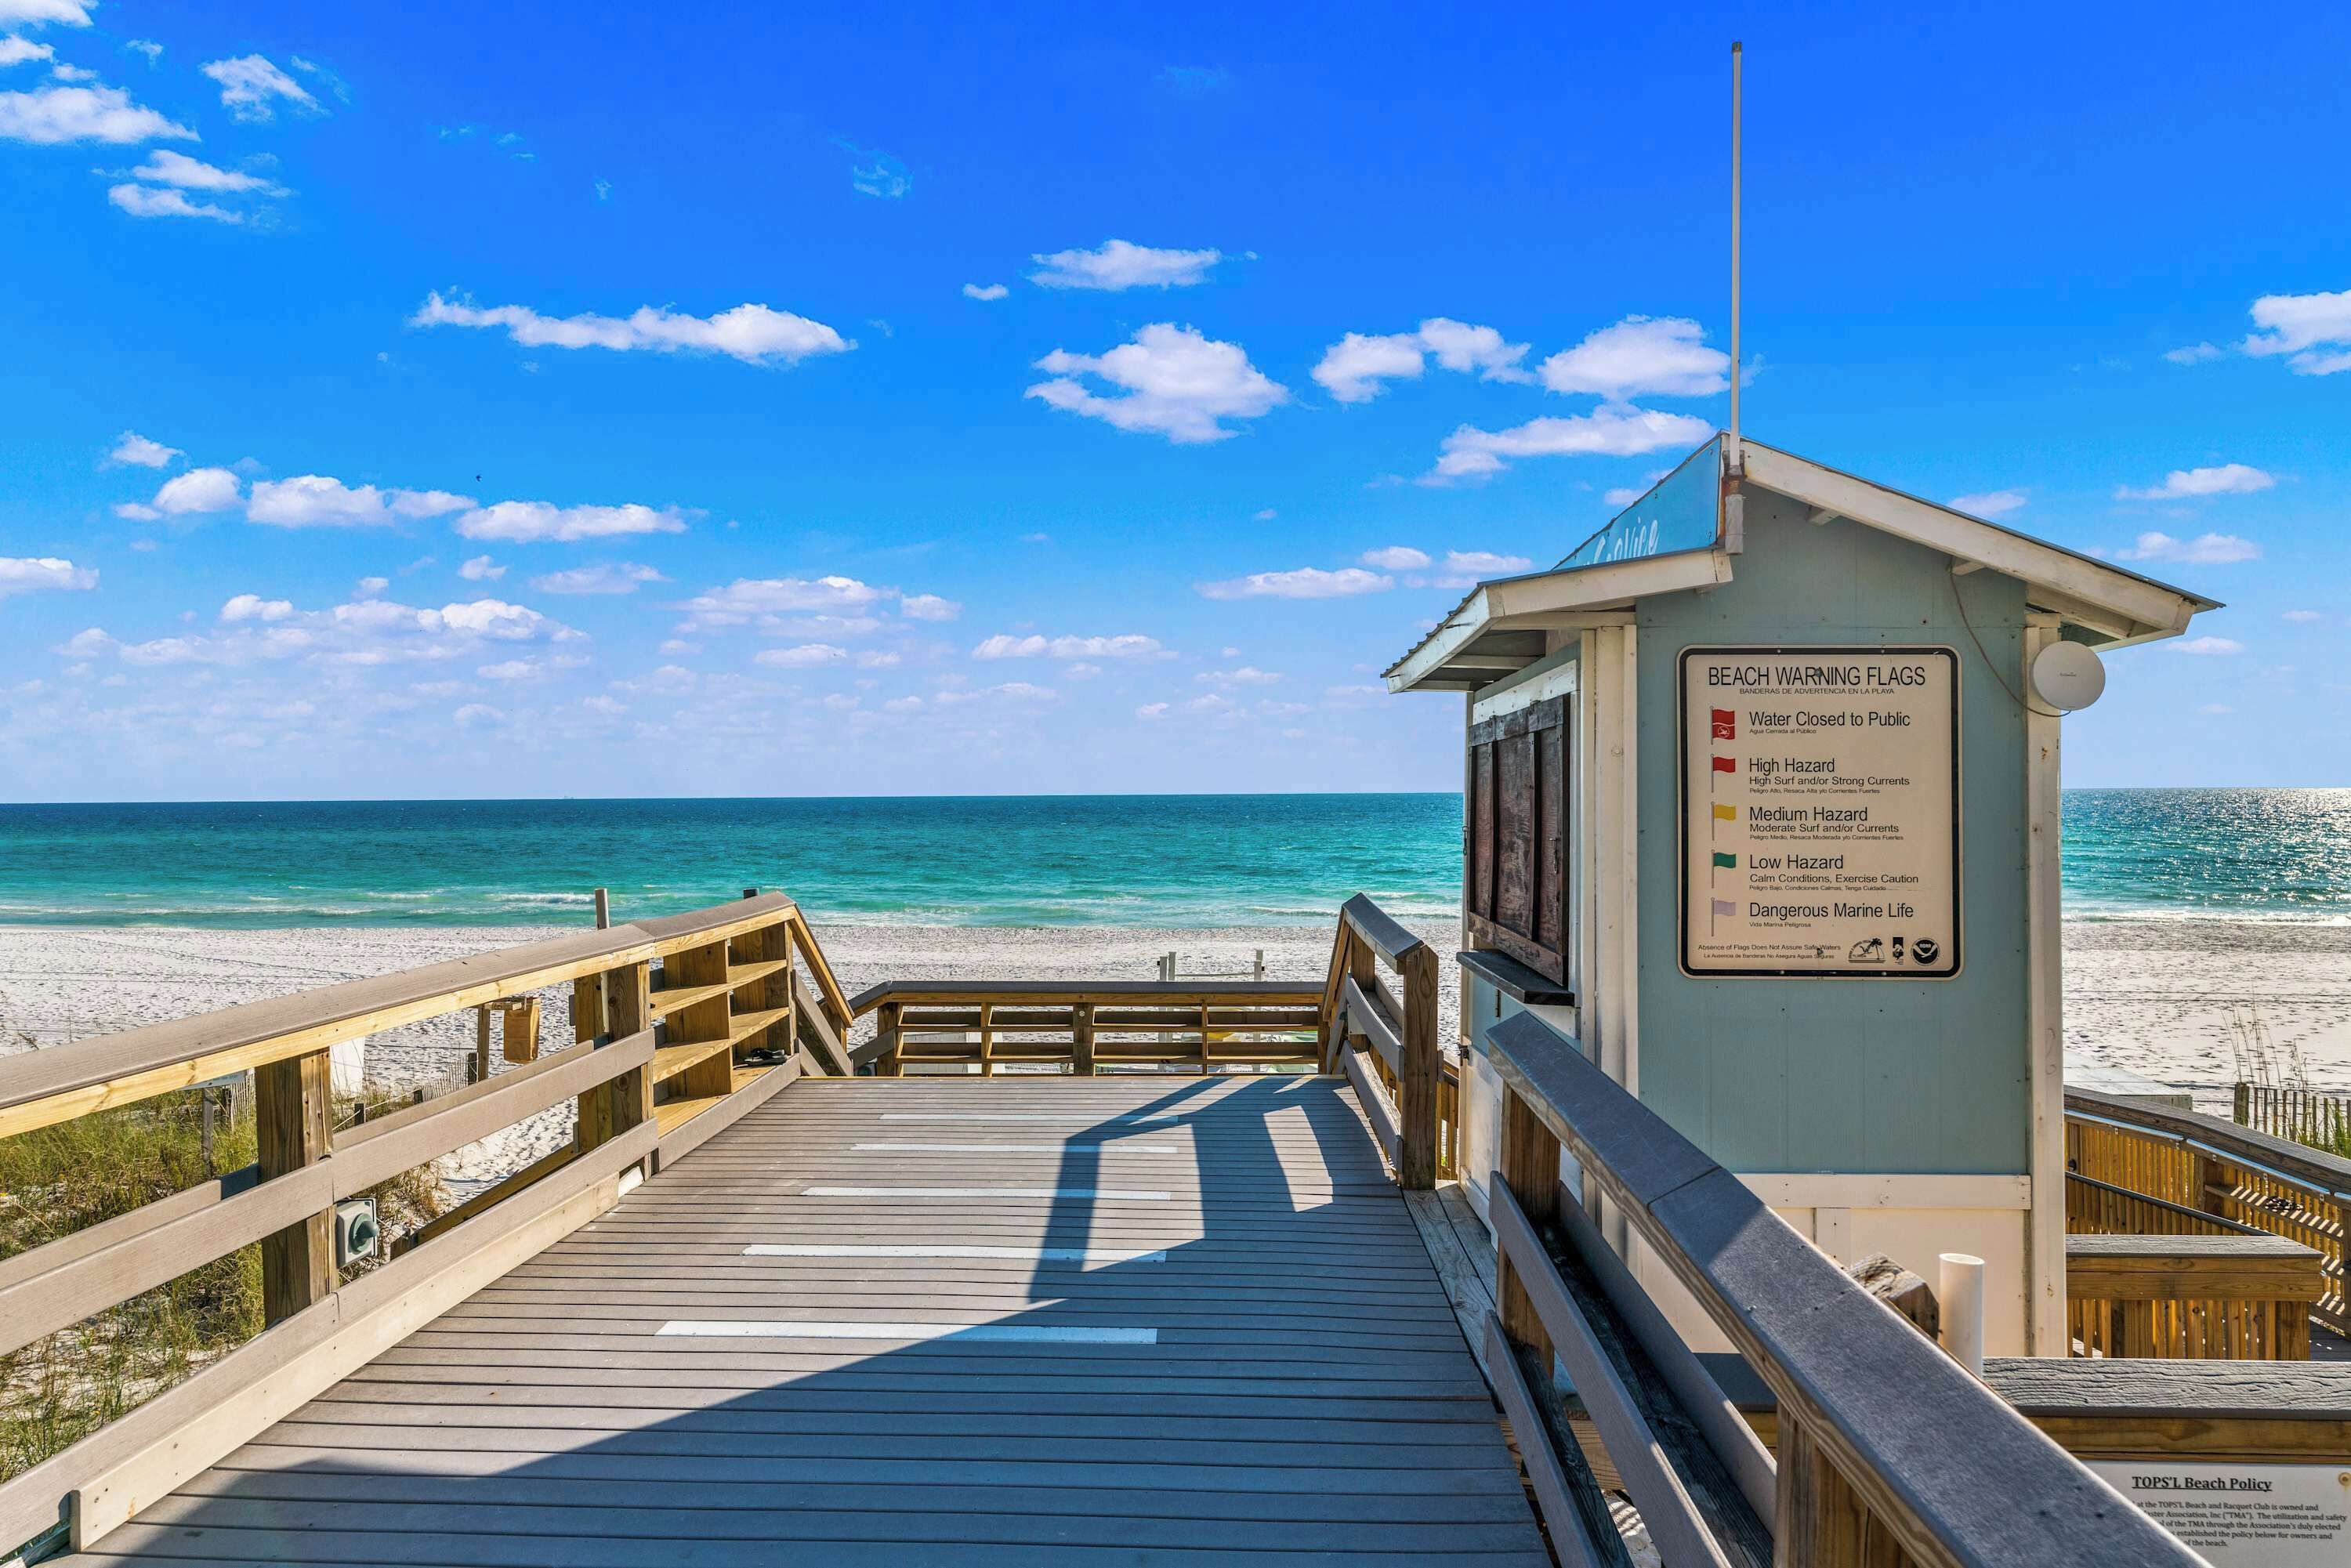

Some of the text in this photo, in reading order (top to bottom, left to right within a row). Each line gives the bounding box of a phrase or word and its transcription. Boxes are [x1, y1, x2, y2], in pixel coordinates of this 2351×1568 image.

[1709, 667, 1925, 686] BEACH WARNING FLAGS
[1749, 712, 1910, 726] Water Closed to Public
[1750, 758, 1834, 776] High Hazard
[1750, 775, 1770, 787] High
[1832, 777, 1864, 787] Strong
[1750, 806, 1867, 821] Medium Hazard
[1750, 824, 1899, 832] Moderate Surf and/or Currents
[1750, 854, 1843, 869] Low Hazard
[1750, 874, 1775, 882] Calm
[1779, 875, 1831, 884] Conditions,
[1881, 875, 1918, 883] Caution
[1750, 903, 1914, 921] Dangerous Marine Life
[2185, 1477, 2226, 1490] Beach
[2230, 1478, 2273, 1492] Policy
[2325, 1514, 2347, 1523] safety
